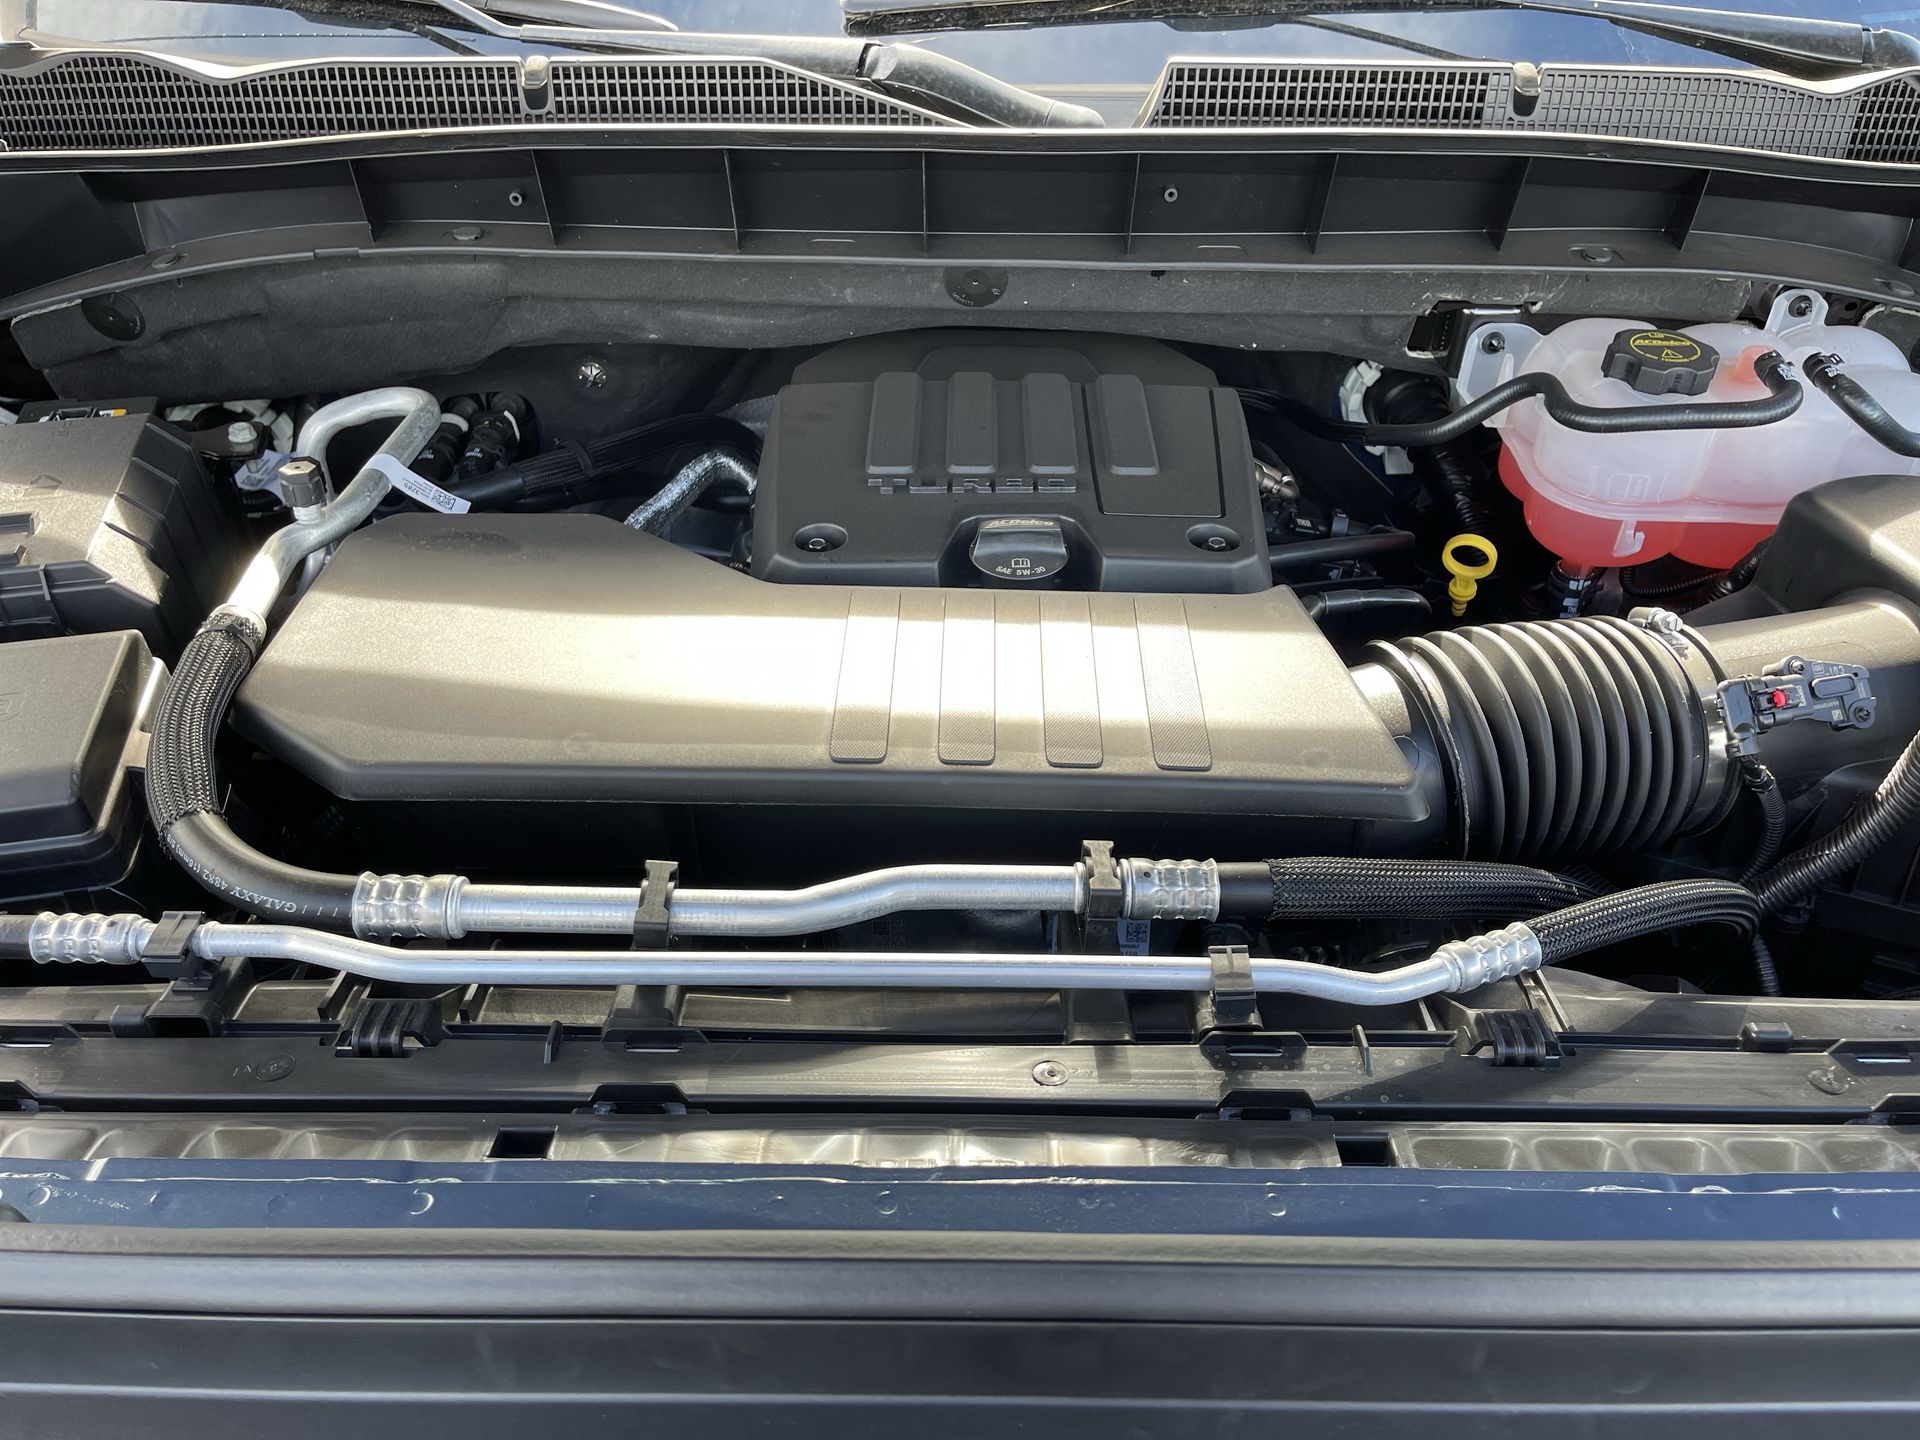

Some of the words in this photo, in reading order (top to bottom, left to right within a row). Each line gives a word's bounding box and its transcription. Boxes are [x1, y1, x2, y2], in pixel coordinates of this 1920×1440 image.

[984, 518, 1055, 529] ACDelco
[995, 565, 1013, 575] SAE
[1016, 566, 1046, 576] 5W-30
[202, 869, 228, 890] 4882
[230, 886, 297, 913] GALAXY
